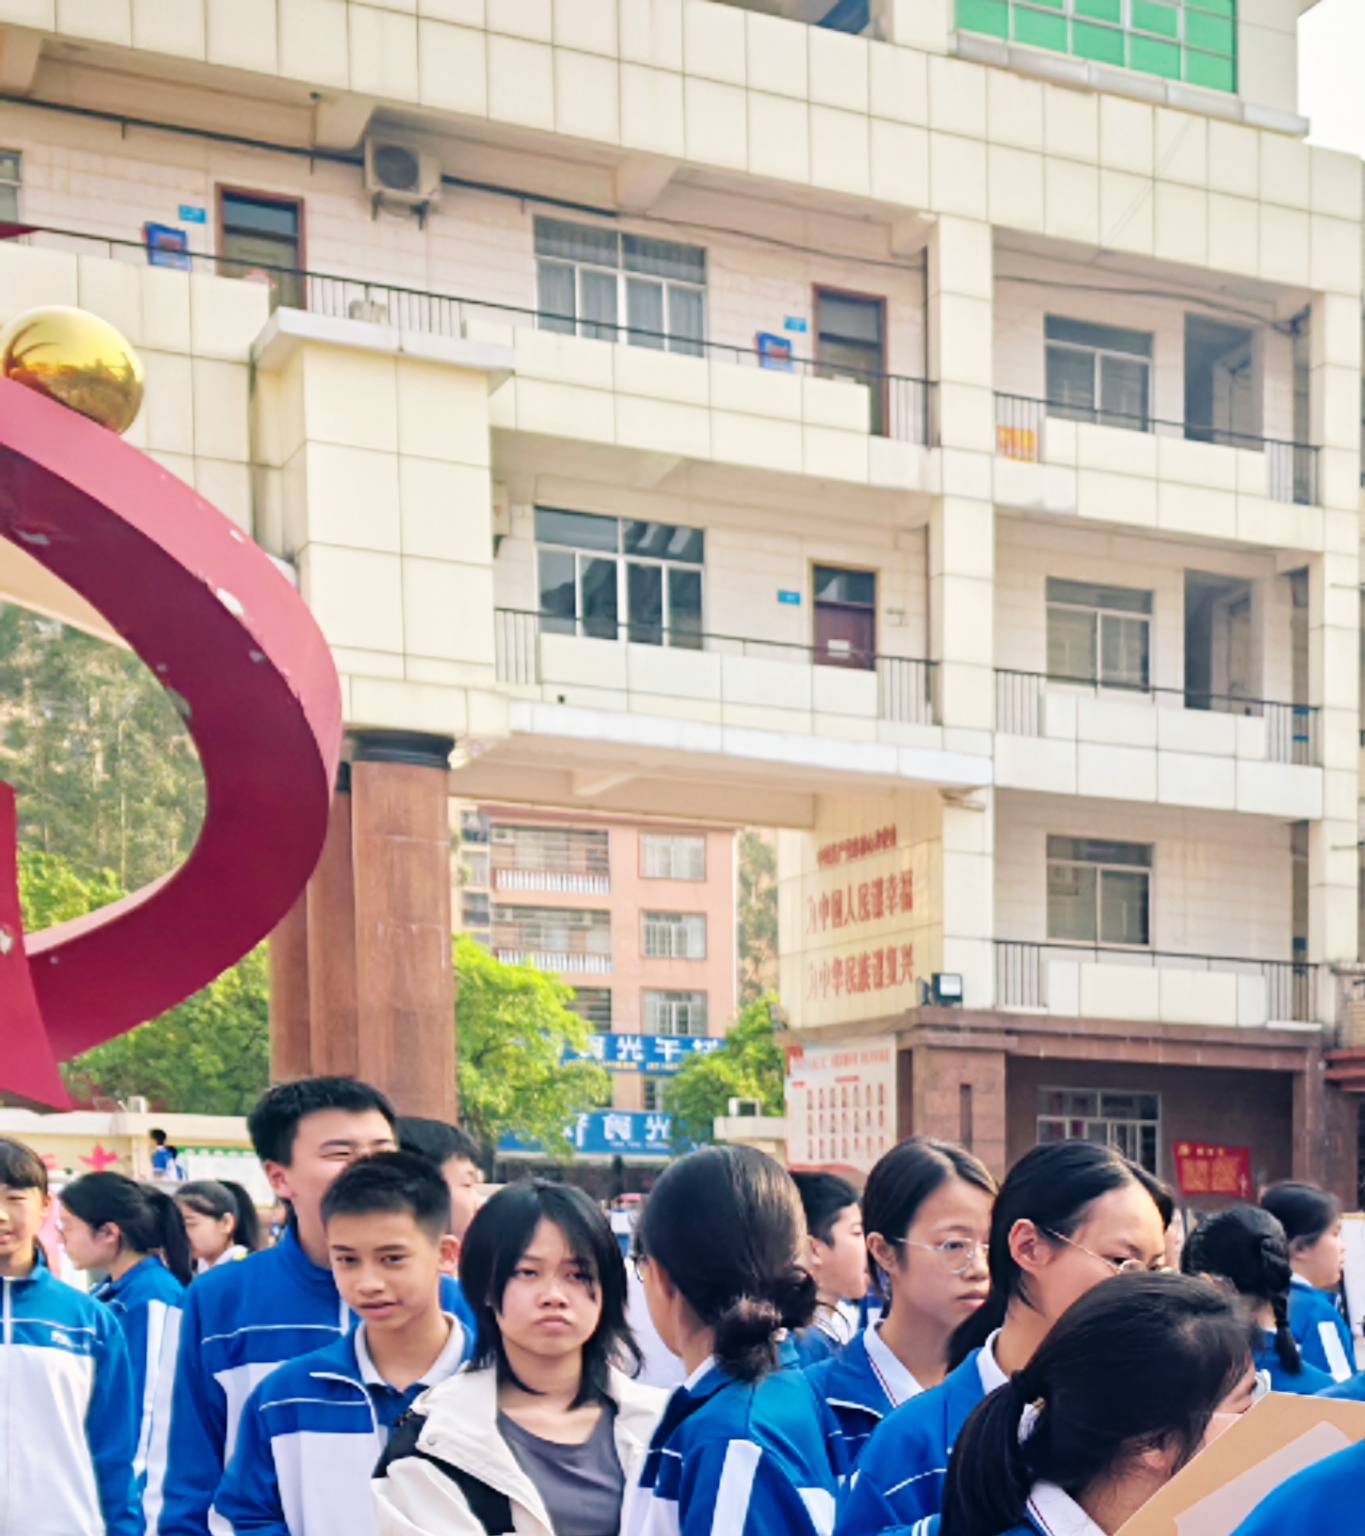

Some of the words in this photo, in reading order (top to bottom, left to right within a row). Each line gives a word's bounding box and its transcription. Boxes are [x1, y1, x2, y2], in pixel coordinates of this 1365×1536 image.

[806, 942, 914, 1002] 为中华民族谋复兴
